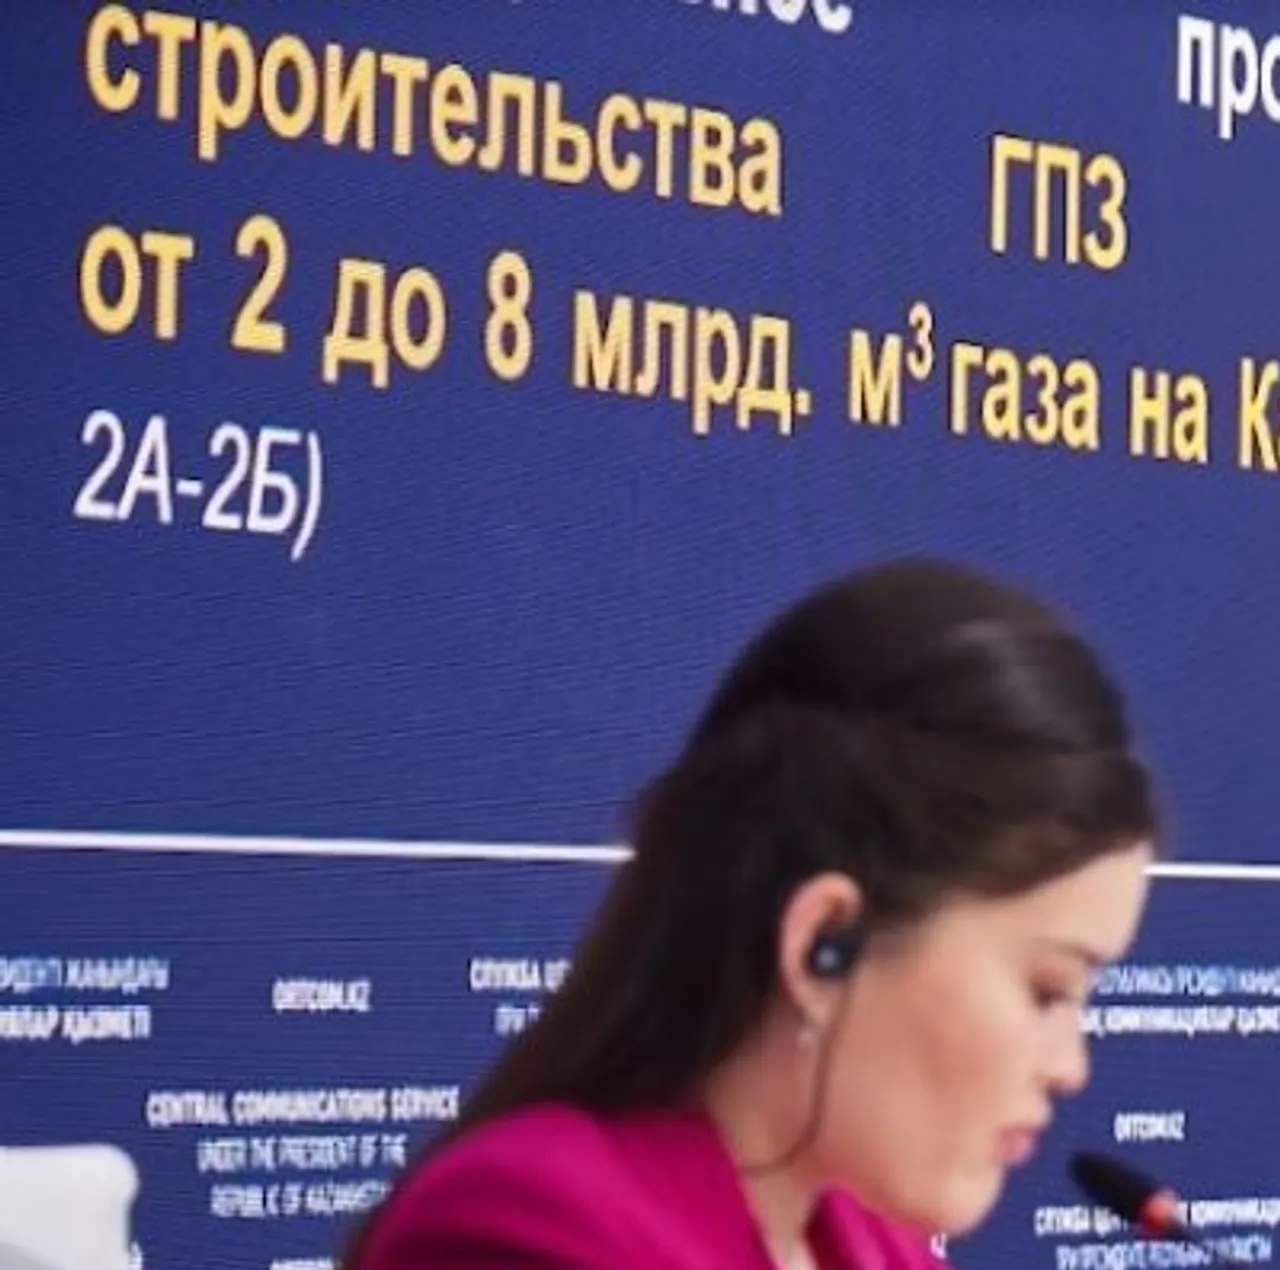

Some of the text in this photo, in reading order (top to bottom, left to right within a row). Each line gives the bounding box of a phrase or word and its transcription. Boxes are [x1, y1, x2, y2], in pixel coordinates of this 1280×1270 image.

[85, 4, 782, 216] строительства
[989, 134, 1128, 270] ГПЗ
[80, 225, 195, 340] от
[231, 214, 289, 353] 2
[322, 259, 448, 389] до
[483, 250, 534, 379] 8
[573, 290, 812, 436] млрд.
[950, 343, 1100, 451] газа
[1129, 367, 1210, 465] на
[73, 409, 322, 560] 2А-2Б)
